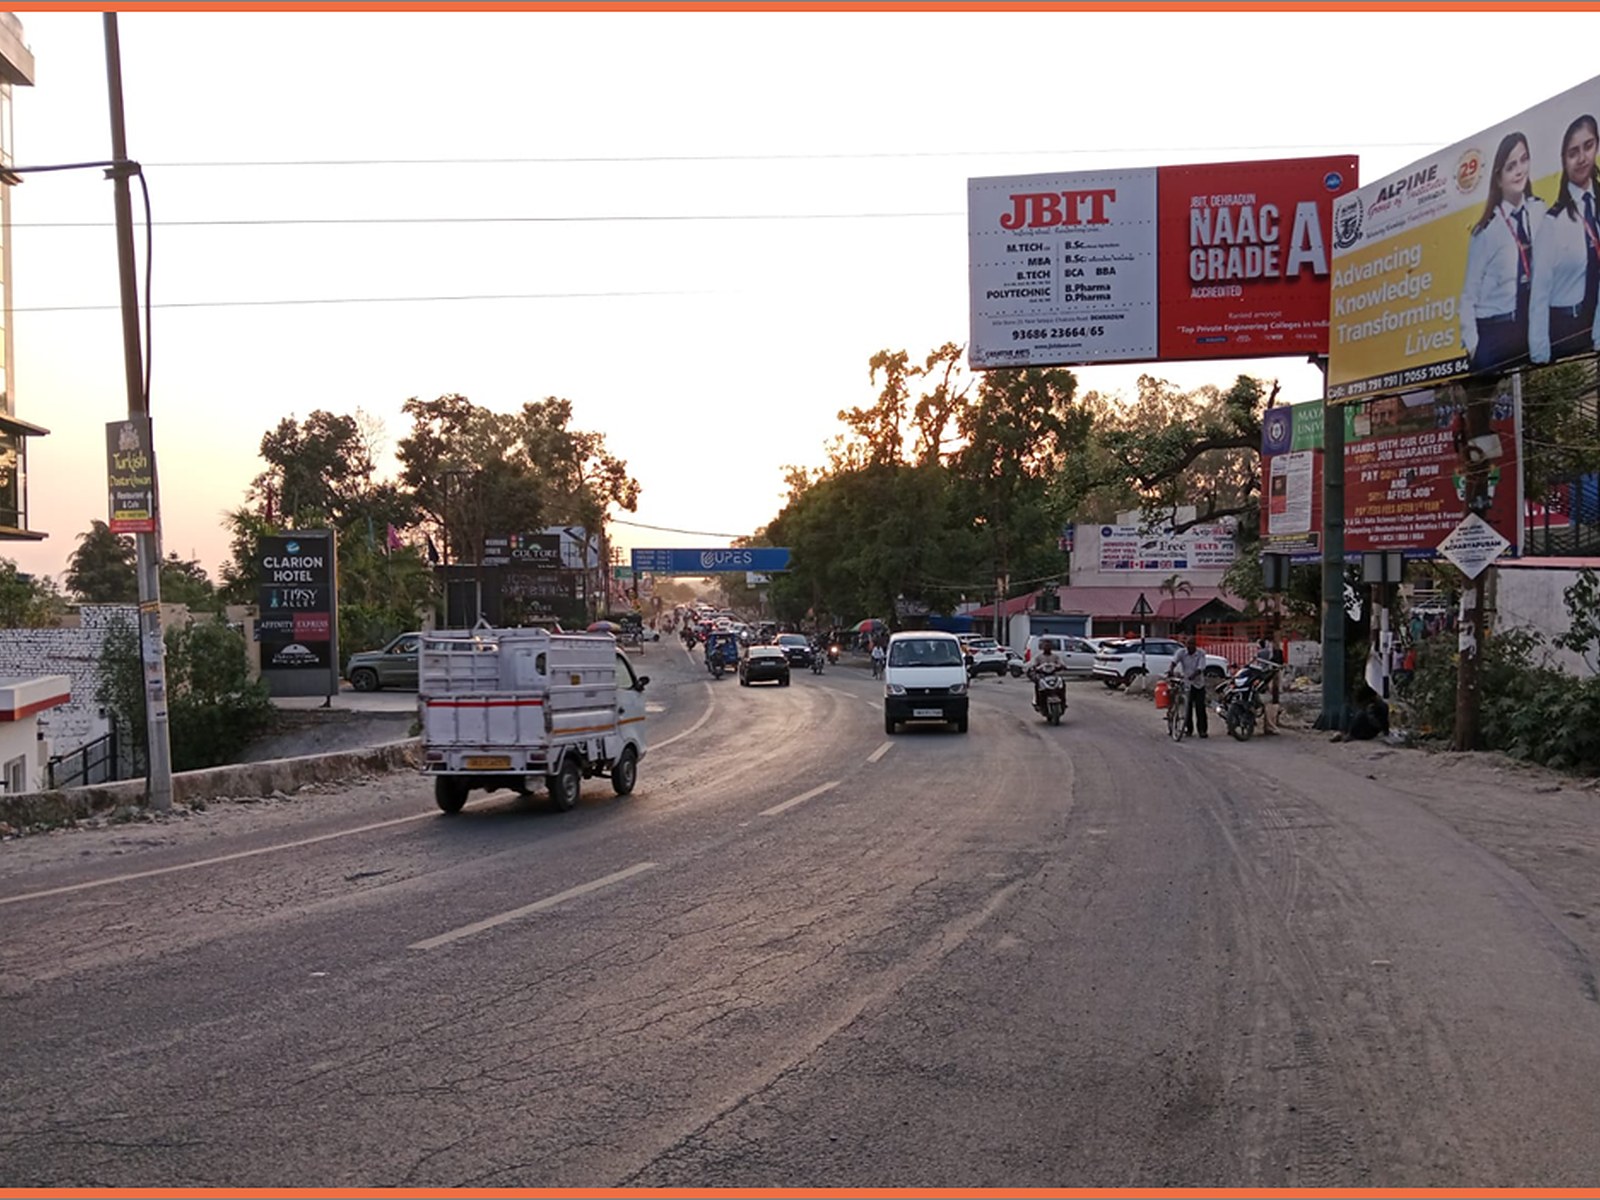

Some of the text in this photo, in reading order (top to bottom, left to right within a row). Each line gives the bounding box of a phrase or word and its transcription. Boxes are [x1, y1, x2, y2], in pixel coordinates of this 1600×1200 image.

[1460, 158, 1478, 178] 29
[1376, 164, 1438, 205] ALPINE
[1211, 194, 1256, 206] DEHRADUN
[999, 188, 1116, 230] JBIT
[1190, 201, 1328, 276] NAAC A
[1006, 243, 1043, 253] M.TECH
[1027, 256, 1051, 266] MBA
[1190, 245, 1280, 281] GRADE
[1332, 244, 1421, 290] Advancing
[1016, 270, 1051, 281] B.TECH
[1064, 266, 1116, 278] BCA BBA
[986, 287, 1051, 299] POLYTECHNIC
[1065, 283, 1111, 294] B.Pharma
[1190, 285, 1242, 298] ACCREDITED
[1335, 272, 1432, 317] Knowledge
[1065, 293, 1111, 303] D.Pharma
[1228, 312, 1252, 320] Ranked
[1337, 297, 1456, 344] Transforming
[1012, 326, 1104, 340] 93686 23664/65
[1224, 322, 1268, 333] Engineering
[1270, 320, 1301, 330] Colleges
[1303, 320, 1311, 328] in
[1405, 328, 1455, 356] Lives
[1348, 382, 1368, 395] 8791
[1404, 370, 1428, 385] 7055
[1429, 365, 1454, 380] 7055
[1455, 359, 1470, 375] 84
[1350, 442, 1376, 454] HANDS
[1378, 438, 1399, 450] WITH
[1400, 436, 1418, 447] OUR
[1419, 433, 1437, 445] CEO
[112, 449, 148, 474] Turkish
[1377, 450, 1393, 461] JOB
[1361, 470, 1378, 482] PAY
[1419, 465, 1439, 476] NOW
[1390, 478, 1408, 488] AND
[1387, 488, 1412, 500] AFTER
[1354, 506, 1365, 516] PAY
[1397, 502, 1414, 513] AFTER
[1158, 541, 1187, 551] Free
[1194, 543, 1220, 551] IELTS
[262, 556, 324, 568] CLARION
[714, 551, 752, 564] UPES
[273, 570, 314, 582] HOTEL
[261, 621, 293, 629] AFFINITY
